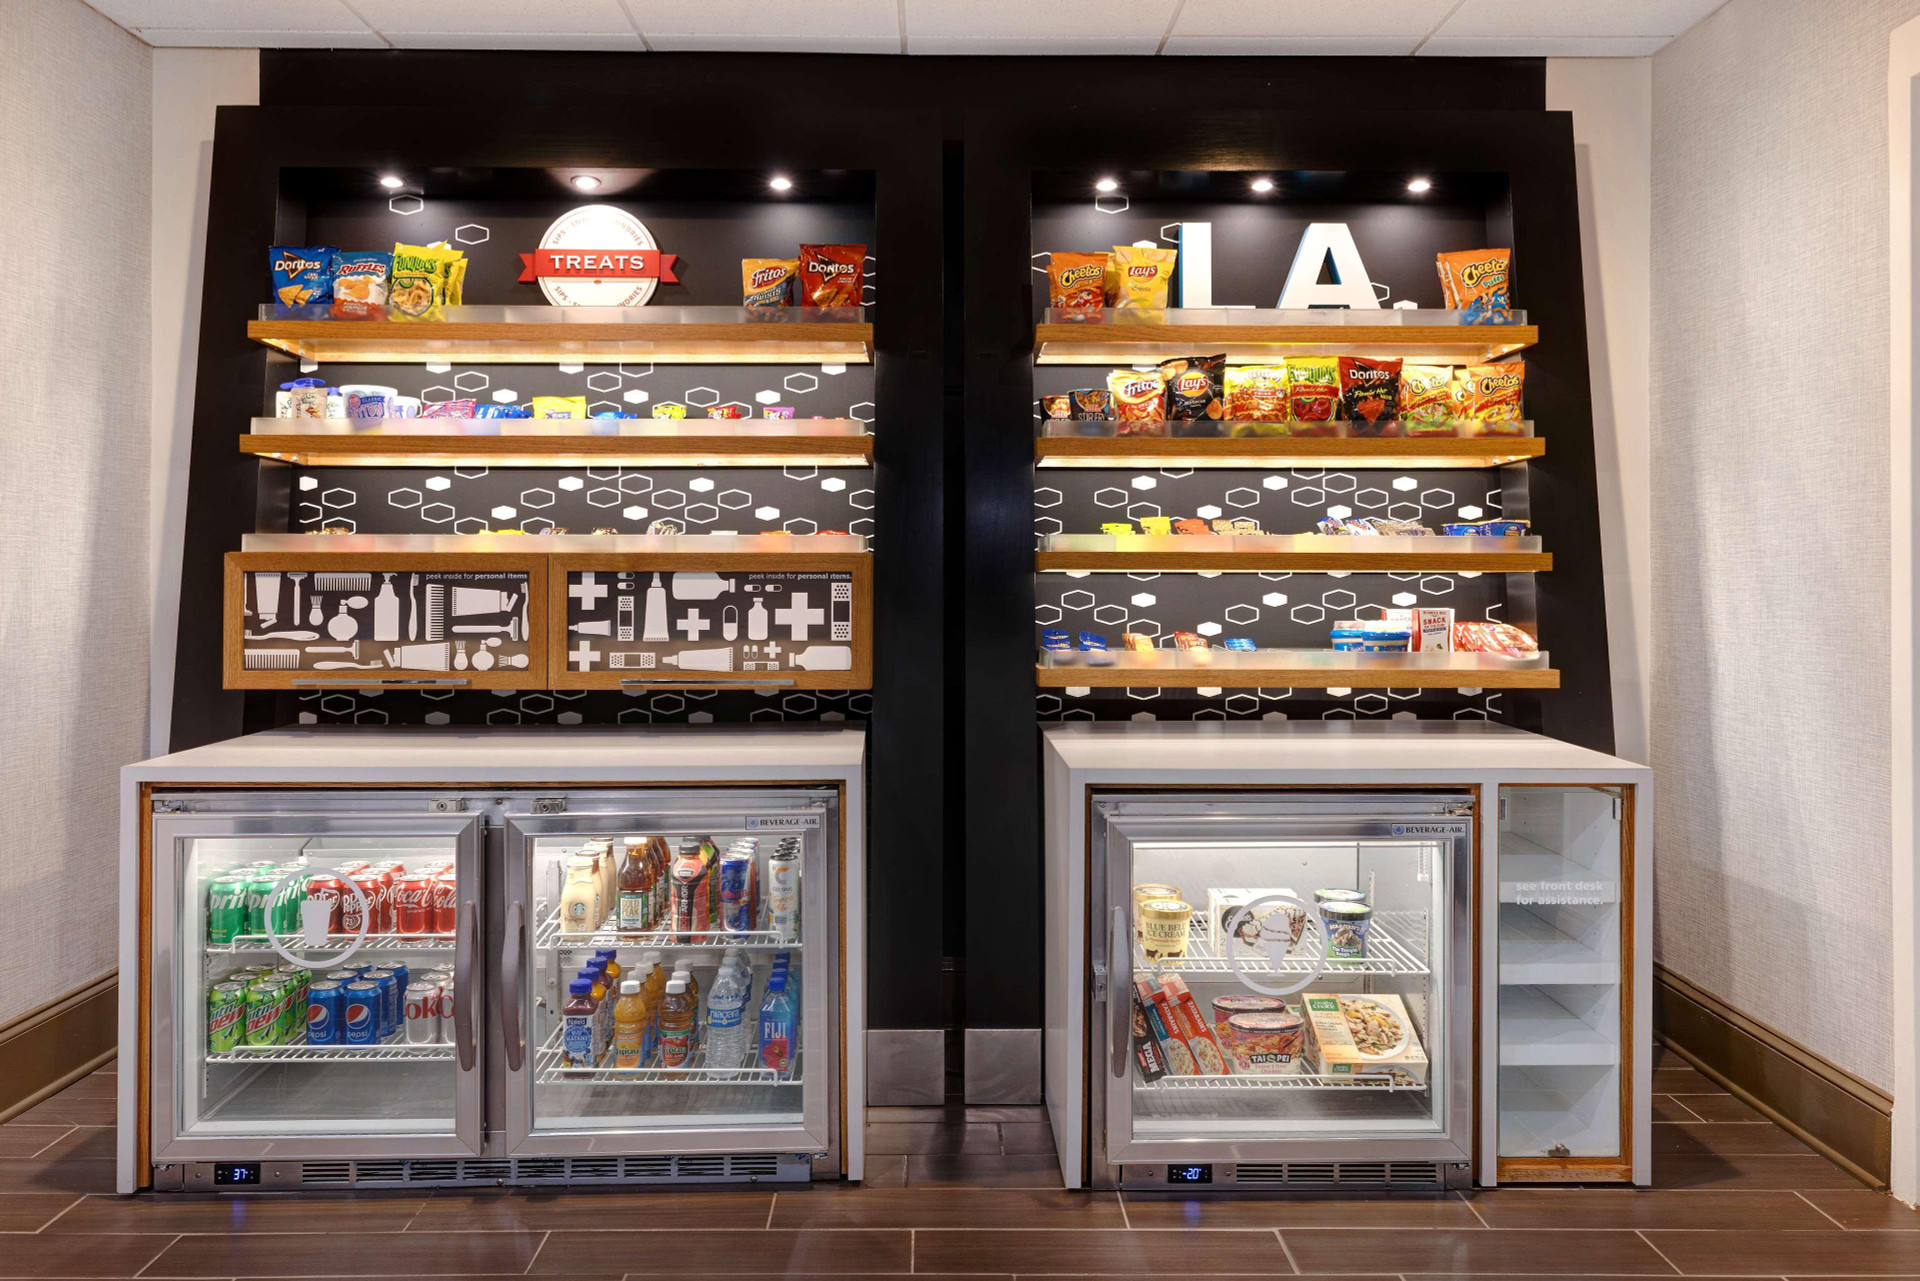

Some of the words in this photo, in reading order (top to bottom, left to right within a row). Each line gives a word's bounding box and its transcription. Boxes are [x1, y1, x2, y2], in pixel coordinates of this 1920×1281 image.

[274, 259, 321, 271] Doritos
[550, 254, 645, 270] TREATS
[808, 261, 856, 274] Doritos
[337, 263, 387, 276] RUFFLES
[1461, 258, 1508, 288] Cheeto
[750, 265, 788, 289] Fritos
[1060, 264, 1103, 289] Cheetos
[1482, 275, 1504, 288] Puffs
[1348, 369, 1390, 380] Doritos
[1181, 376, 1207, 392] Lay's
[1480, 374, 1520, 396] Cheetos
[749, 573, 764, 581] peek
[797, 573, 828, 581] personal
[1423, 617, 1446, 625] SNACK
[1516, 883, 1537, 891] see
[1540, 881, 1572, 891] front
[1575, 881, 1603, 891] desk
[1516, 896, 1533, 905] for
[1537, 896, 1604, 905] assistance.
[1145, 922, 1165, 931] BLUE
[709, 1010, 739, 1020] niagara
[764, 1021, 787, 1039] FIJI
[1250, 1055, 1266, 1063] TAI
[1276, 1055, 1290, 1063] PEI
